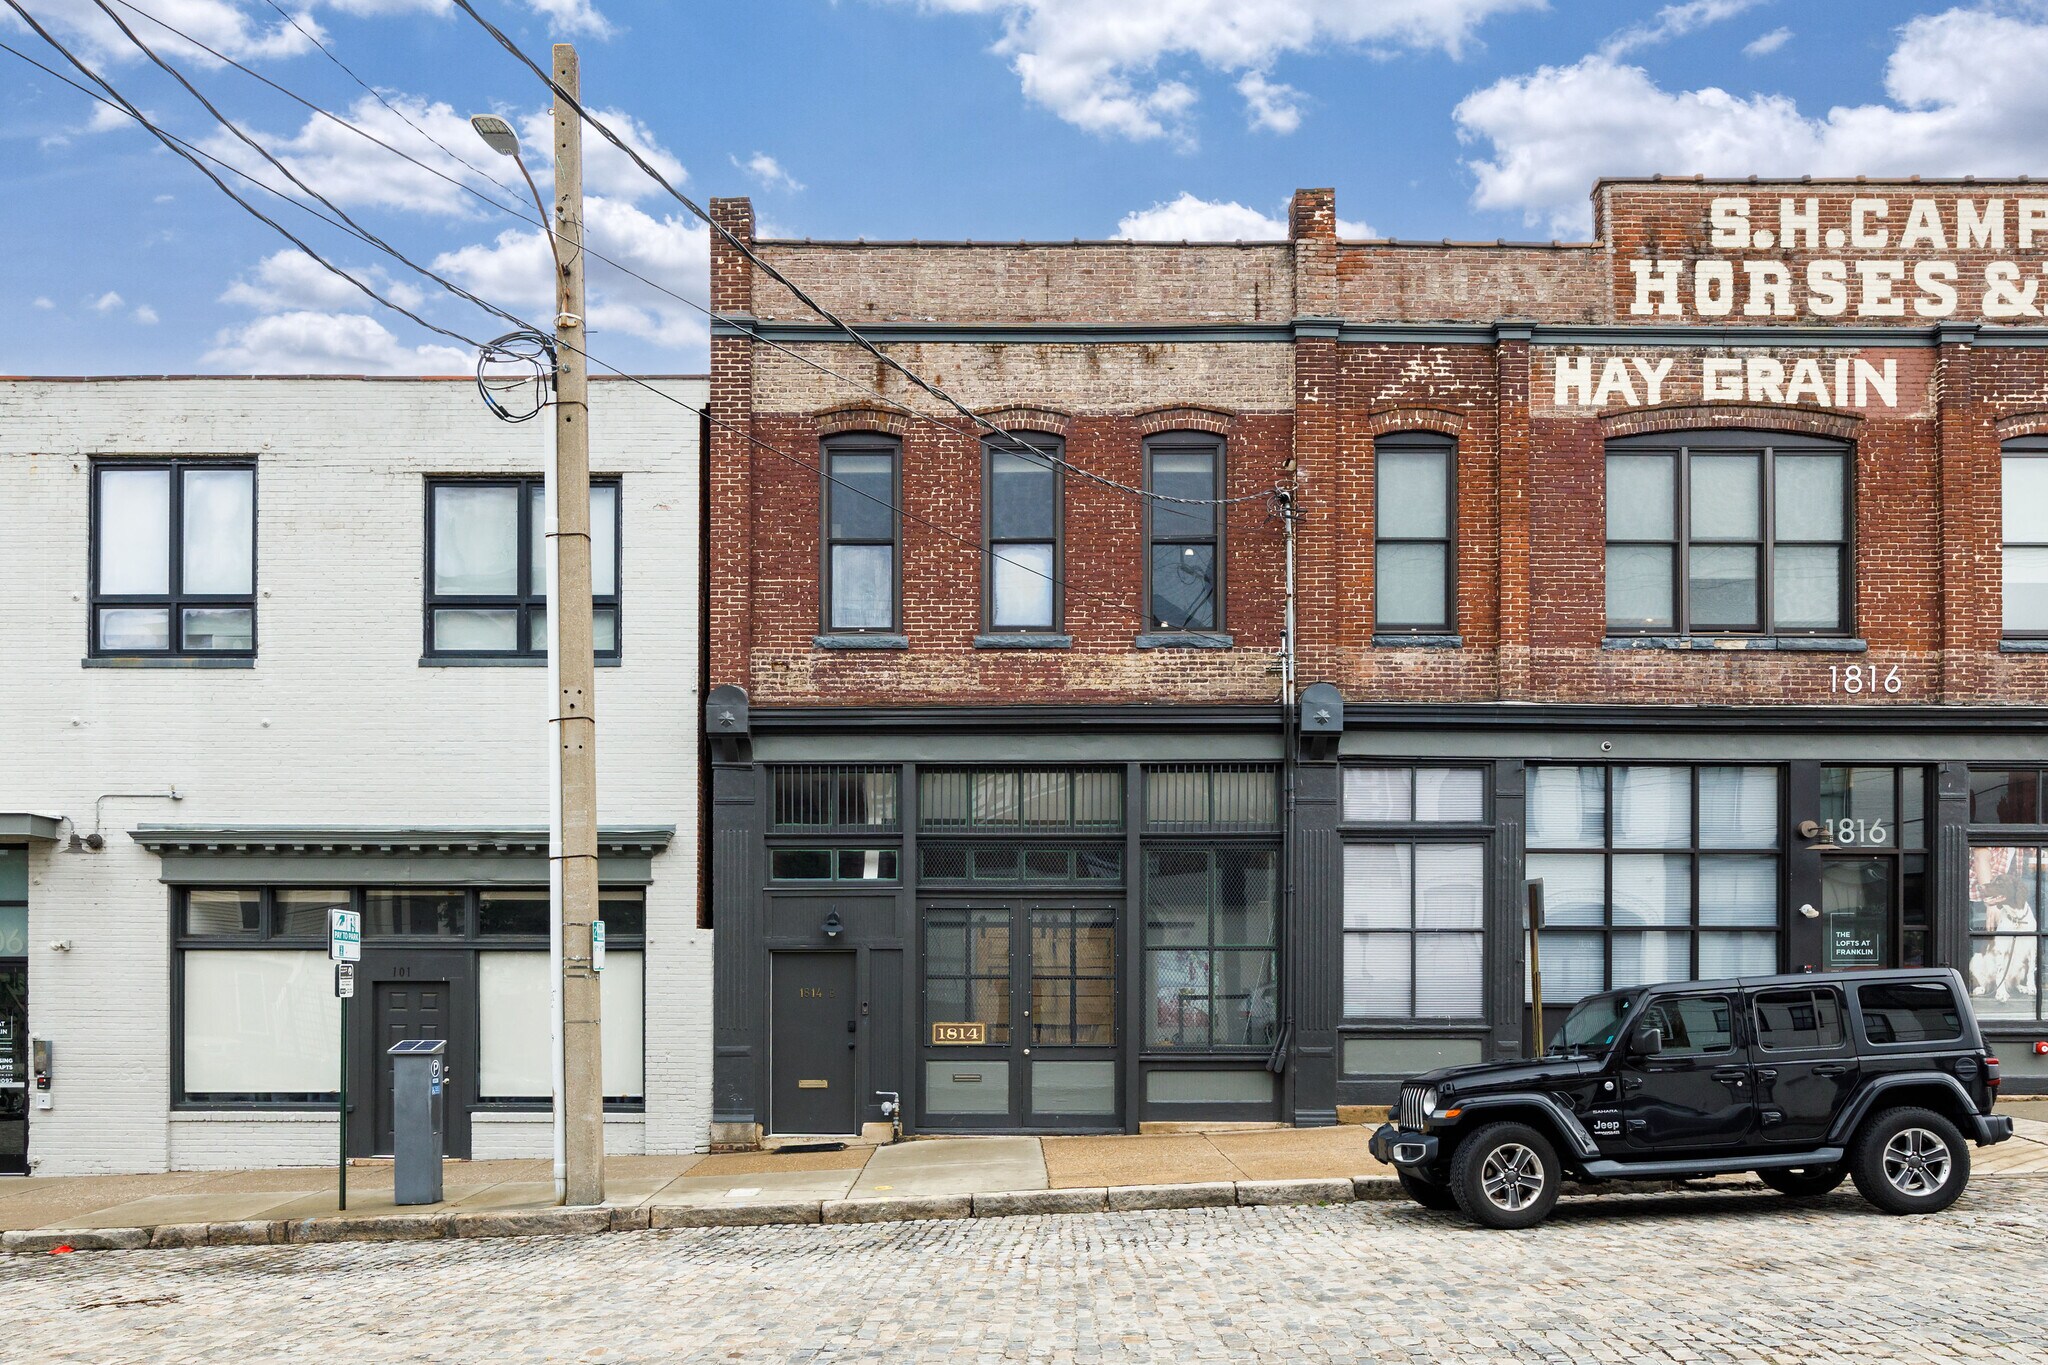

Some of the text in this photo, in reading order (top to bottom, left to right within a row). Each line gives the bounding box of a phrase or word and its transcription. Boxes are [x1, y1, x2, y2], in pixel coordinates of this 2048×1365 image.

[1629, 258, 2044, 317] HORSES &
[1553, 355, 1898, 408] HAY GRAIN
[1828, 664, 1902, 693] 1816
[1825, 817, 1887, 843] 1816
[334, 930, 359, 941] PAY TO PARK
[393, 966, 410, 978] 101
[799, 987, 823, 998] 1814
[938, 1027, 979, 1040] 1814
[1593, 1120, 1620, 1130] Jeep
